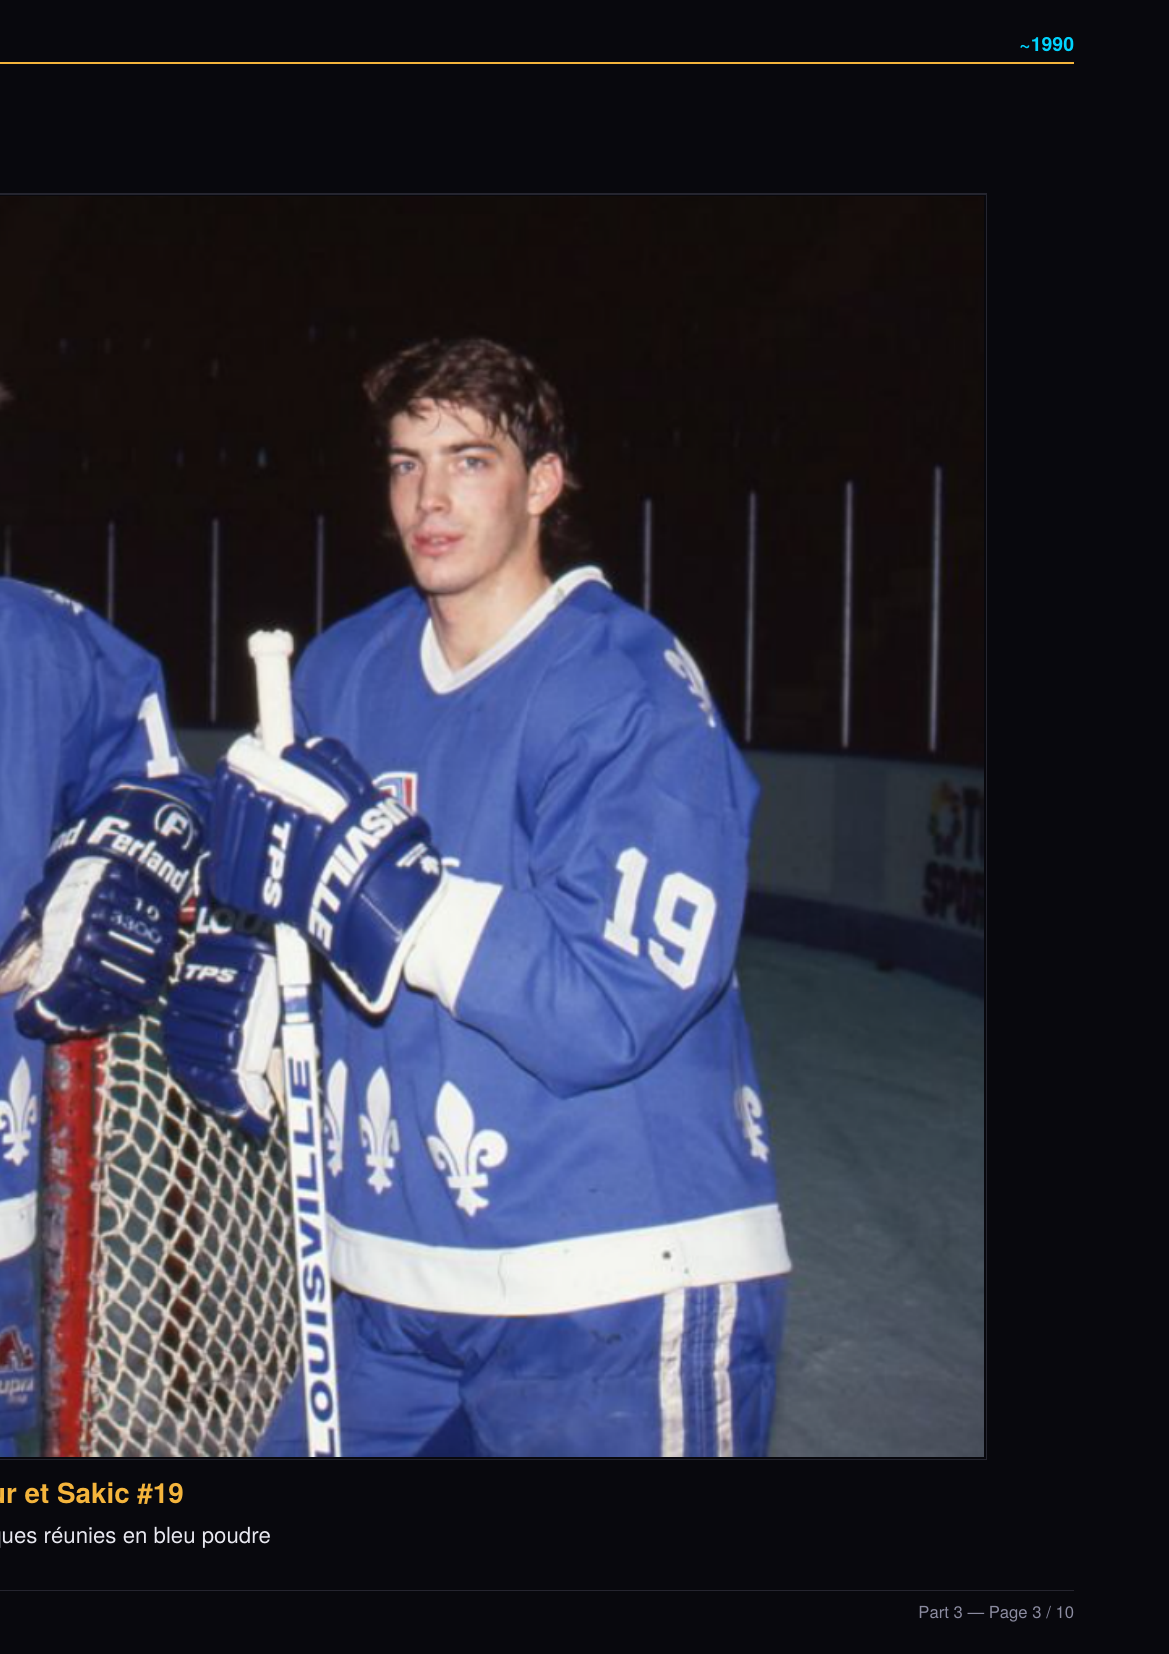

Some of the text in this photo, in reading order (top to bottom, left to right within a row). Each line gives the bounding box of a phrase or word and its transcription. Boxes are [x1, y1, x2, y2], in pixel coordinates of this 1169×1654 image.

[87, 816, 189, 893] Ferland
[263, 822, 291, 908] TPS
[603, 847, 716, 989] 19
[184, 963, 238, 983] TPS
